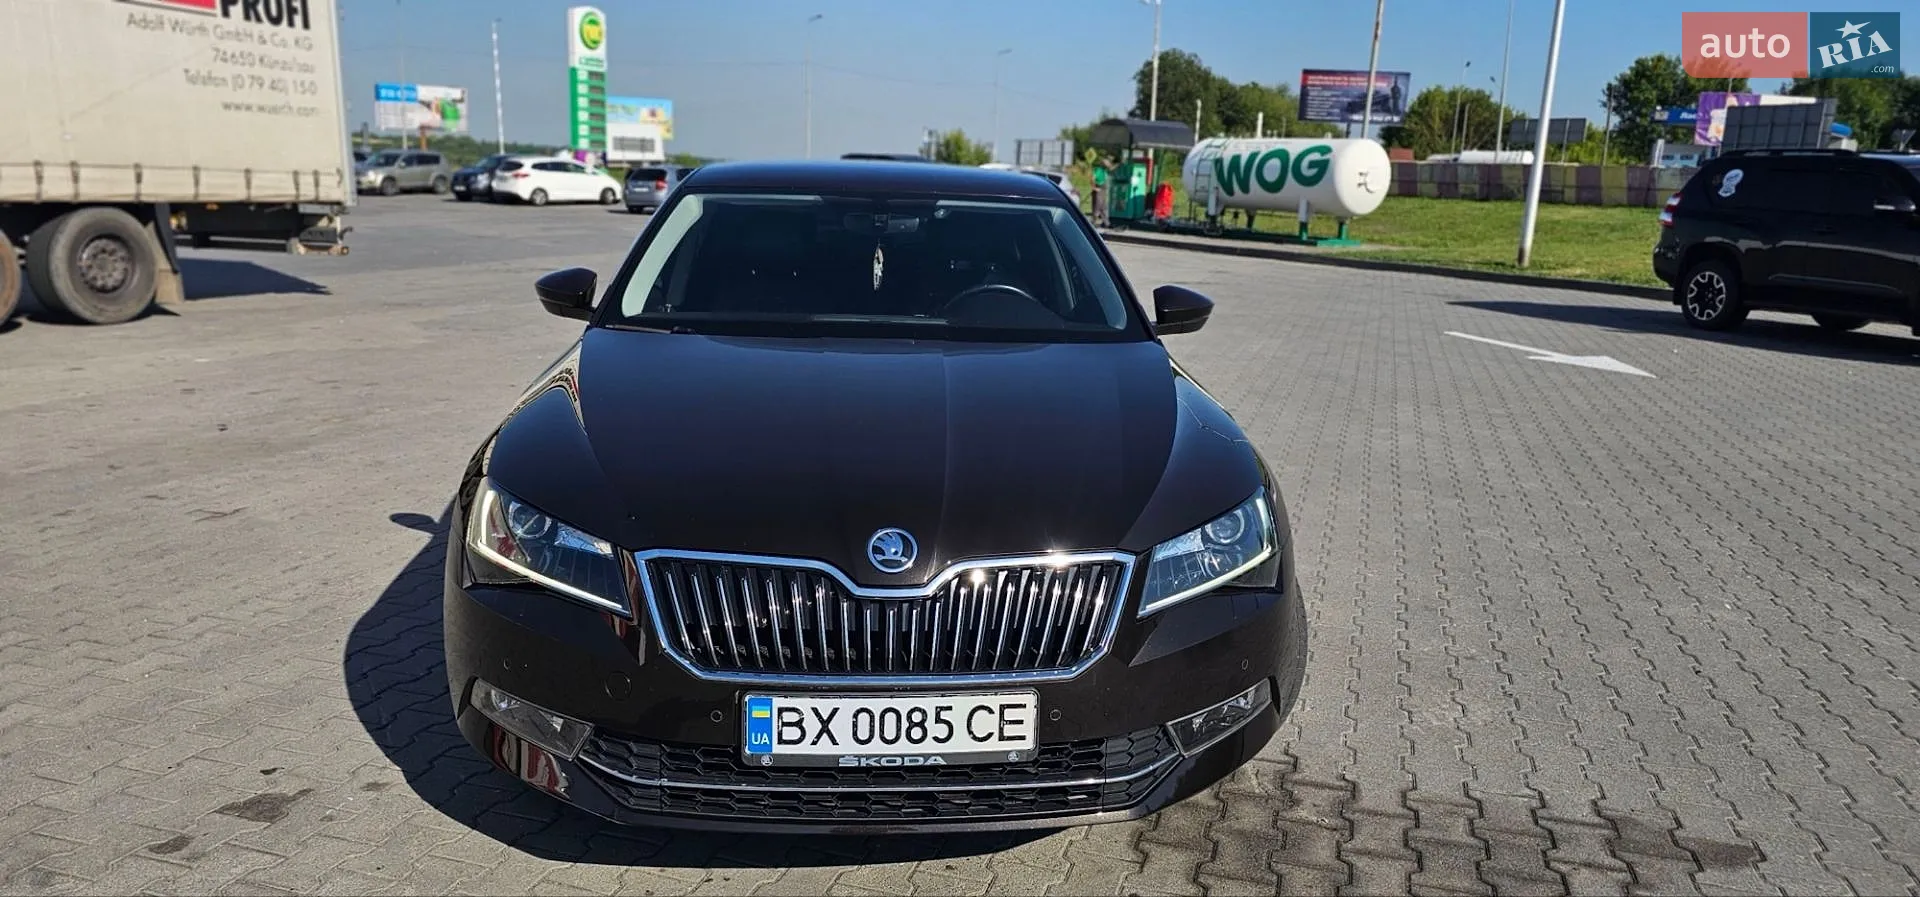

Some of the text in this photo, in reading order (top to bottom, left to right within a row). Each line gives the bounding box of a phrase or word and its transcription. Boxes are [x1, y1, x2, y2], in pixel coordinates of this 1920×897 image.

[126, 12, 165, 31] Adolf
[220, 0, 311, 30] PROFI
[1213, 144, 1333, 197] WOG
[777, 703, 1027, 747] BX 0085 CE
[751, 733, 770, 745] UA
[838, 755, 947, 768] ŠKODA
